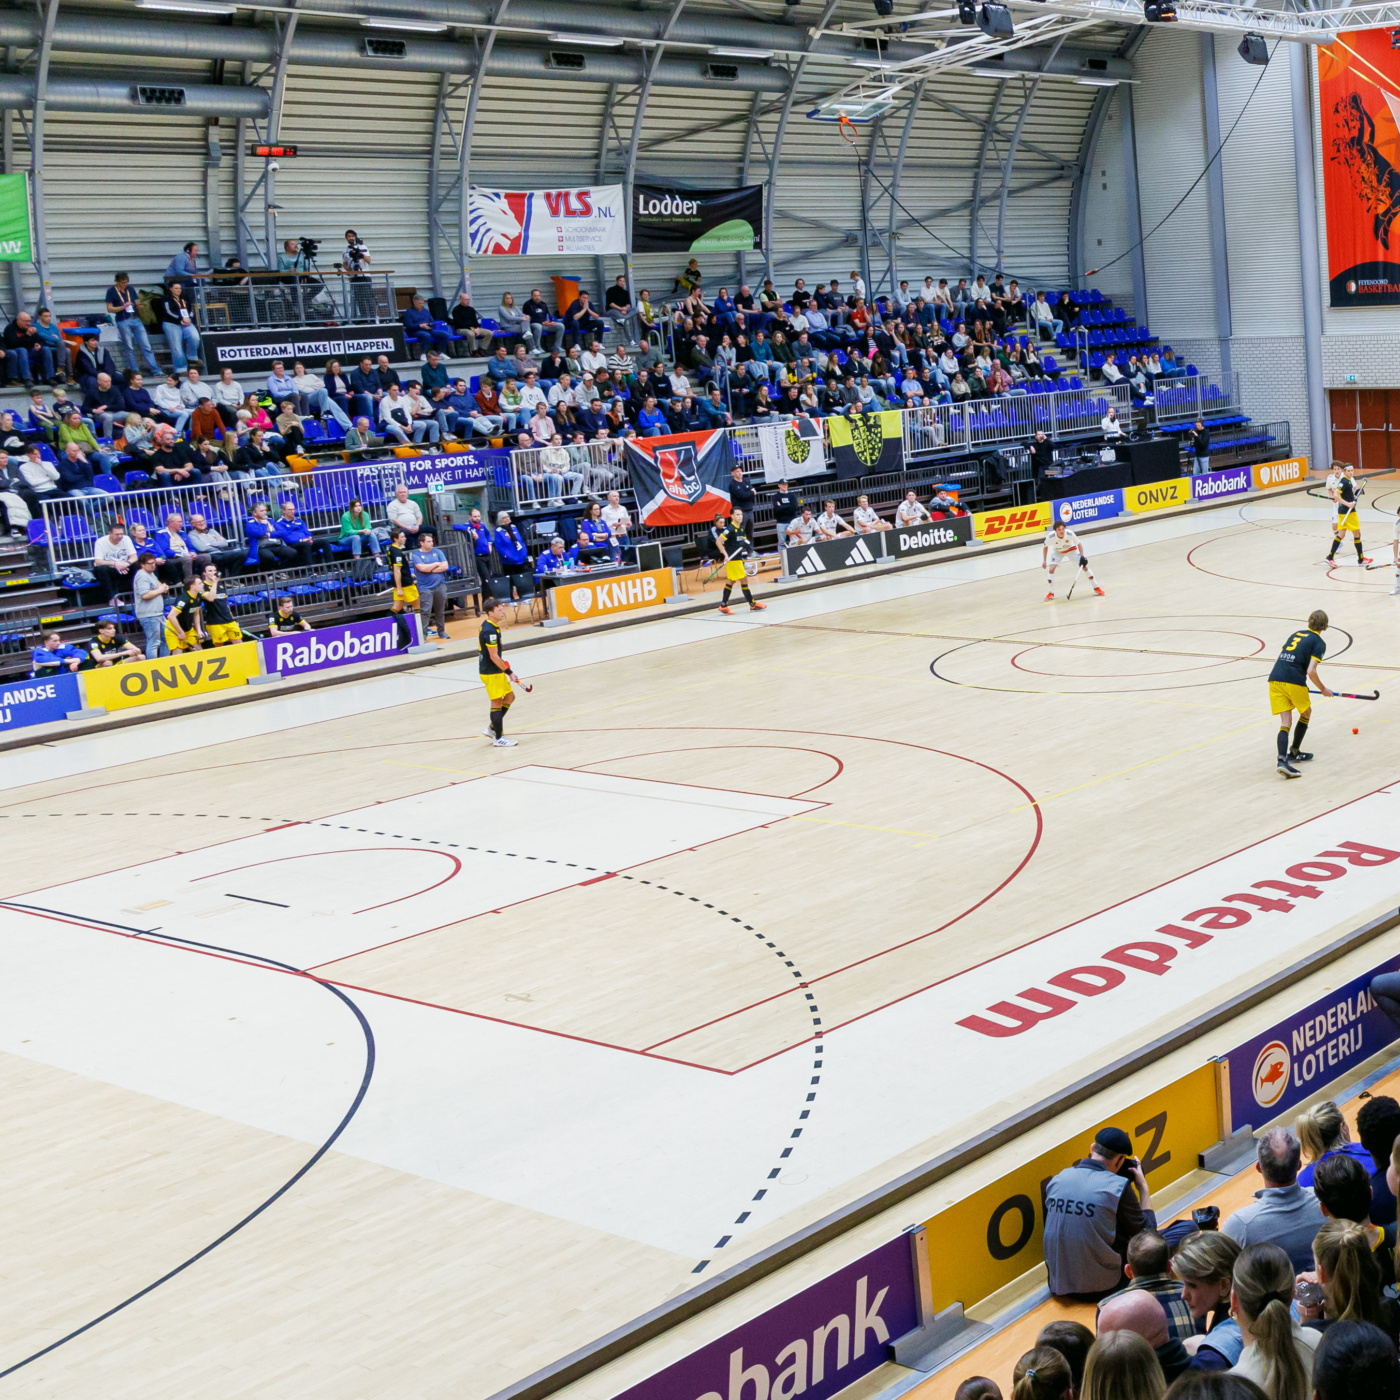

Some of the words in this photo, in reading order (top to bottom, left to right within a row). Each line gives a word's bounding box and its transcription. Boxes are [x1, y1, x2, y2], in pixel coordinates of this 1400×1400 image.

[638, 194, 699, 215] Lodder
[220, 344, 292, 359] ROTTERDAM.
[296, 342, 329, 355] MAKE
[332, 342, 343, 353] IT
[347, 340, 393, 352] HAPPEN.
[410, 459, 433, 472] FOR
[434, 455, 479, 468] SPORTS.
[1271, 461, 1300, 482] KNHB
[424, 470, 453, 484] MAKE
[455, 469, 462, 480] IT
[465, 466, 494, 479] HAPPE
[1195, 472, 1247, 498] Rabobank
[1072, 495, 1115, 511] NEDERLANDSE
[1137, 485, 1178, 506] ONVZ
[984, 509, 1042, 536] DHL
[1072, 507, 1098, 521] LOTERIJ
[596, 576, 657, 610] KNHB
[1286, 637, 1302, 652] 3
[120, 656, 230, 697] ONVZ
[0, 684, 57, 707] ANDSE
[1293, 1023, 1363, 1088] LOTERIJ
[1050, 1197, 1096, 1218] PRESS
[696, 1275, 891, 1400] bank
